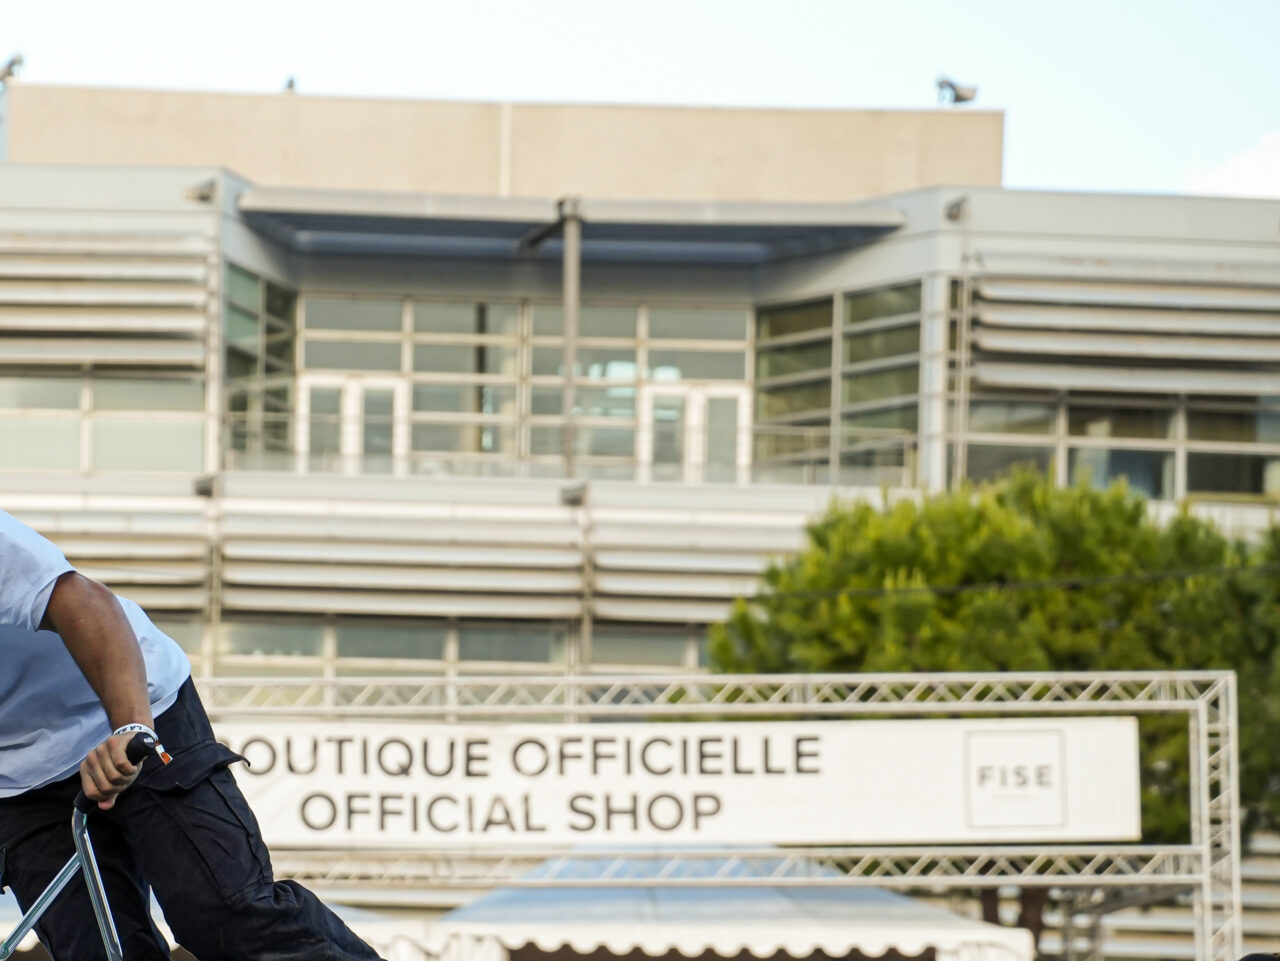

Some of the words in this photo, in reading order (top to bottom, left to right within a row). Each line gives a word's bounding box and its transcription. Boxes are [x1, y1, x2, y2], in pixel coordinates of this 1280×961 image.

[217, 737, 490, 777] OUTIQUE
[512, 735, 823, 777] OFFICIELLE
[976, 764, 1054, 790] FISE
[300, 793, 547, 833] OFFICIAL
[568, 793, 723, 833] SHOP
